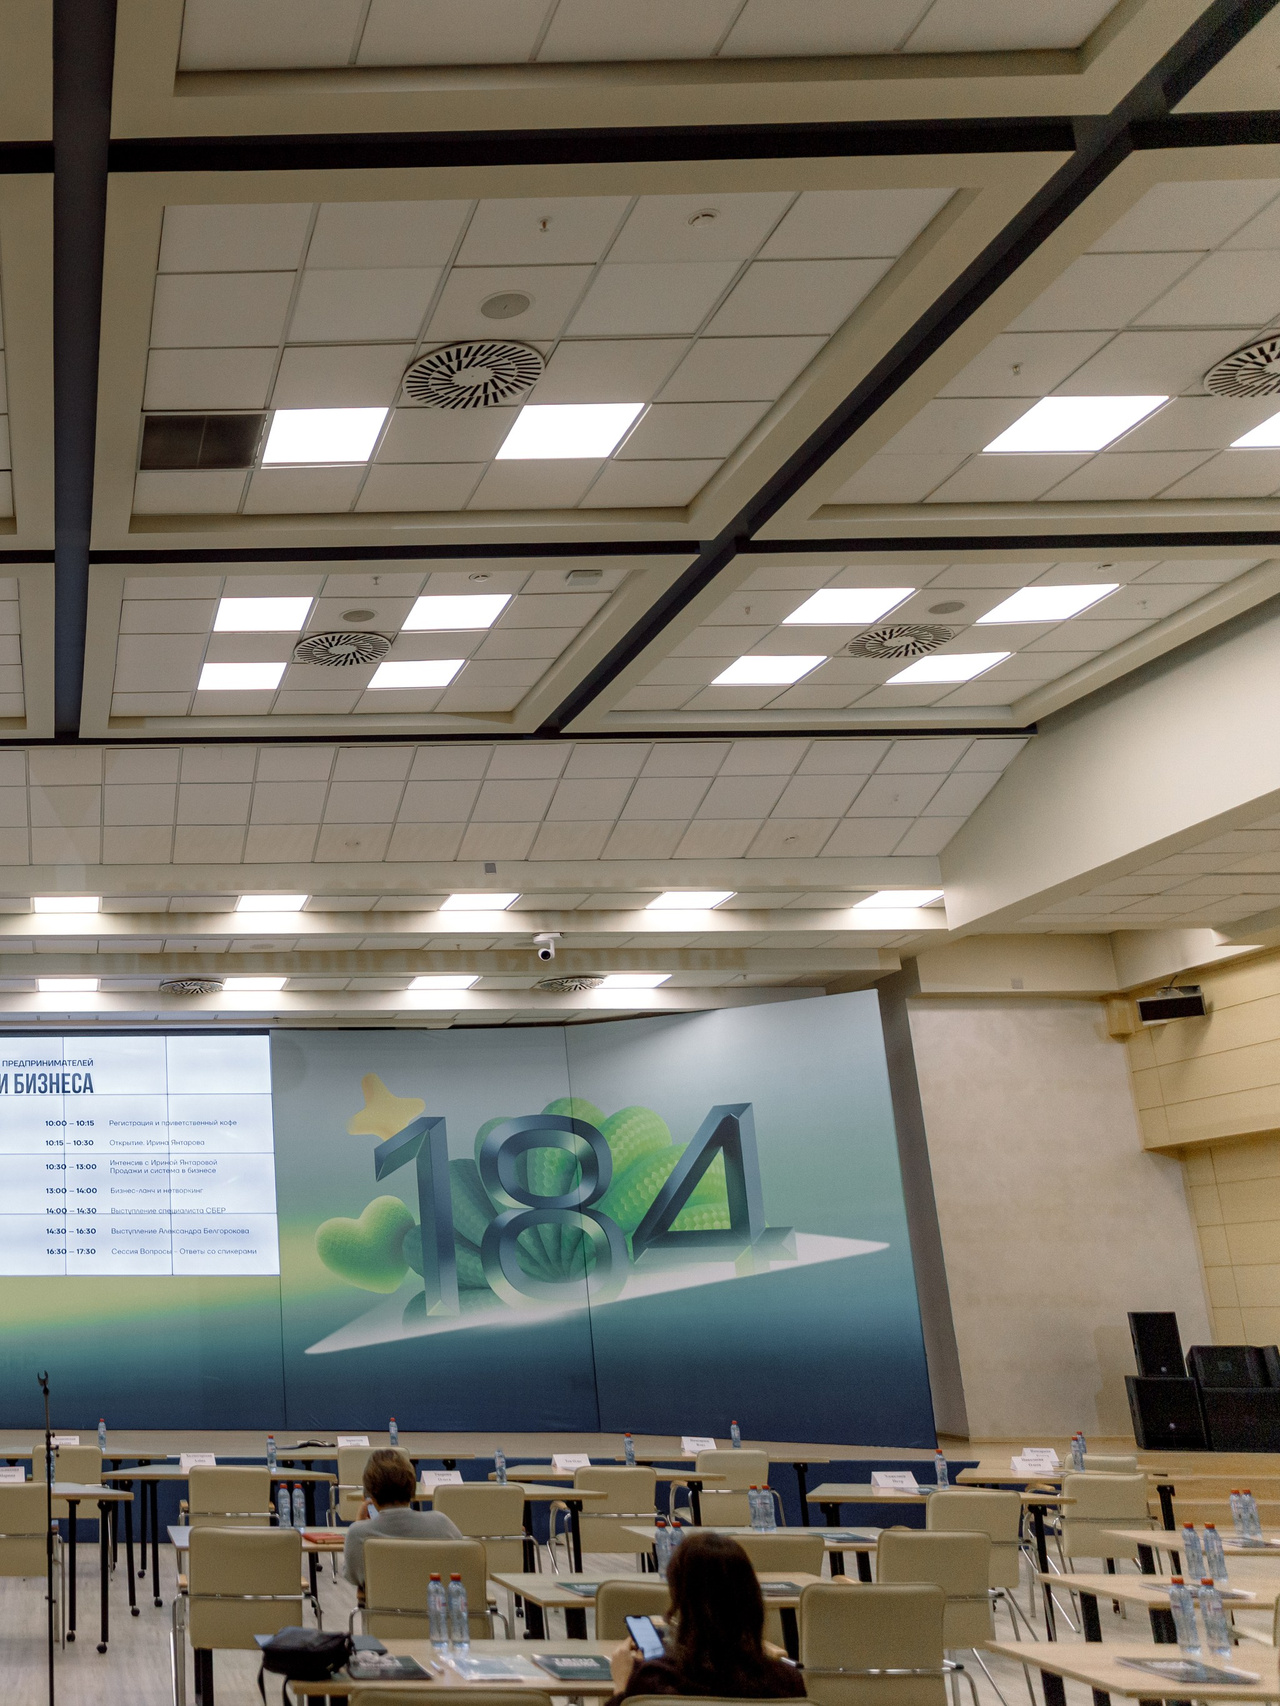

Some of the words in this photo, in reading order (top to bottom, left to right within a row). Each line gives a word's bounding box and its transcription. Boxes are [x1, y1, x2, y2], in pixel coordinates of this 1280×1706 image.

[2, 1058, 94, 1068] ПРЕДПРИНИМАТЕЛЕЙ
[13, 1073, 94, 1094] БИЗНЕСА
[161, 1119, 218, 1127] приветственный
[220, 1120, 238, 1128] кофе
[109, 1139, 145, 1147] Открытие.
[146, 1139, 170, 1147] Ирина
[170, 1139, 205, 1147] Янтарова
[150, 1158, 178, 1167] Ириной
[179, 1158, 218, 1167] Янтаровой
[374, 1101, 796, 1318] 184
[111, 1228, 157, 1236] Выступление
[158, 1228, 202, 1236] Александра
[203, 1228, 250, 1236] Белгорокова
[140, 1248, 172, 1256] Вопросы
